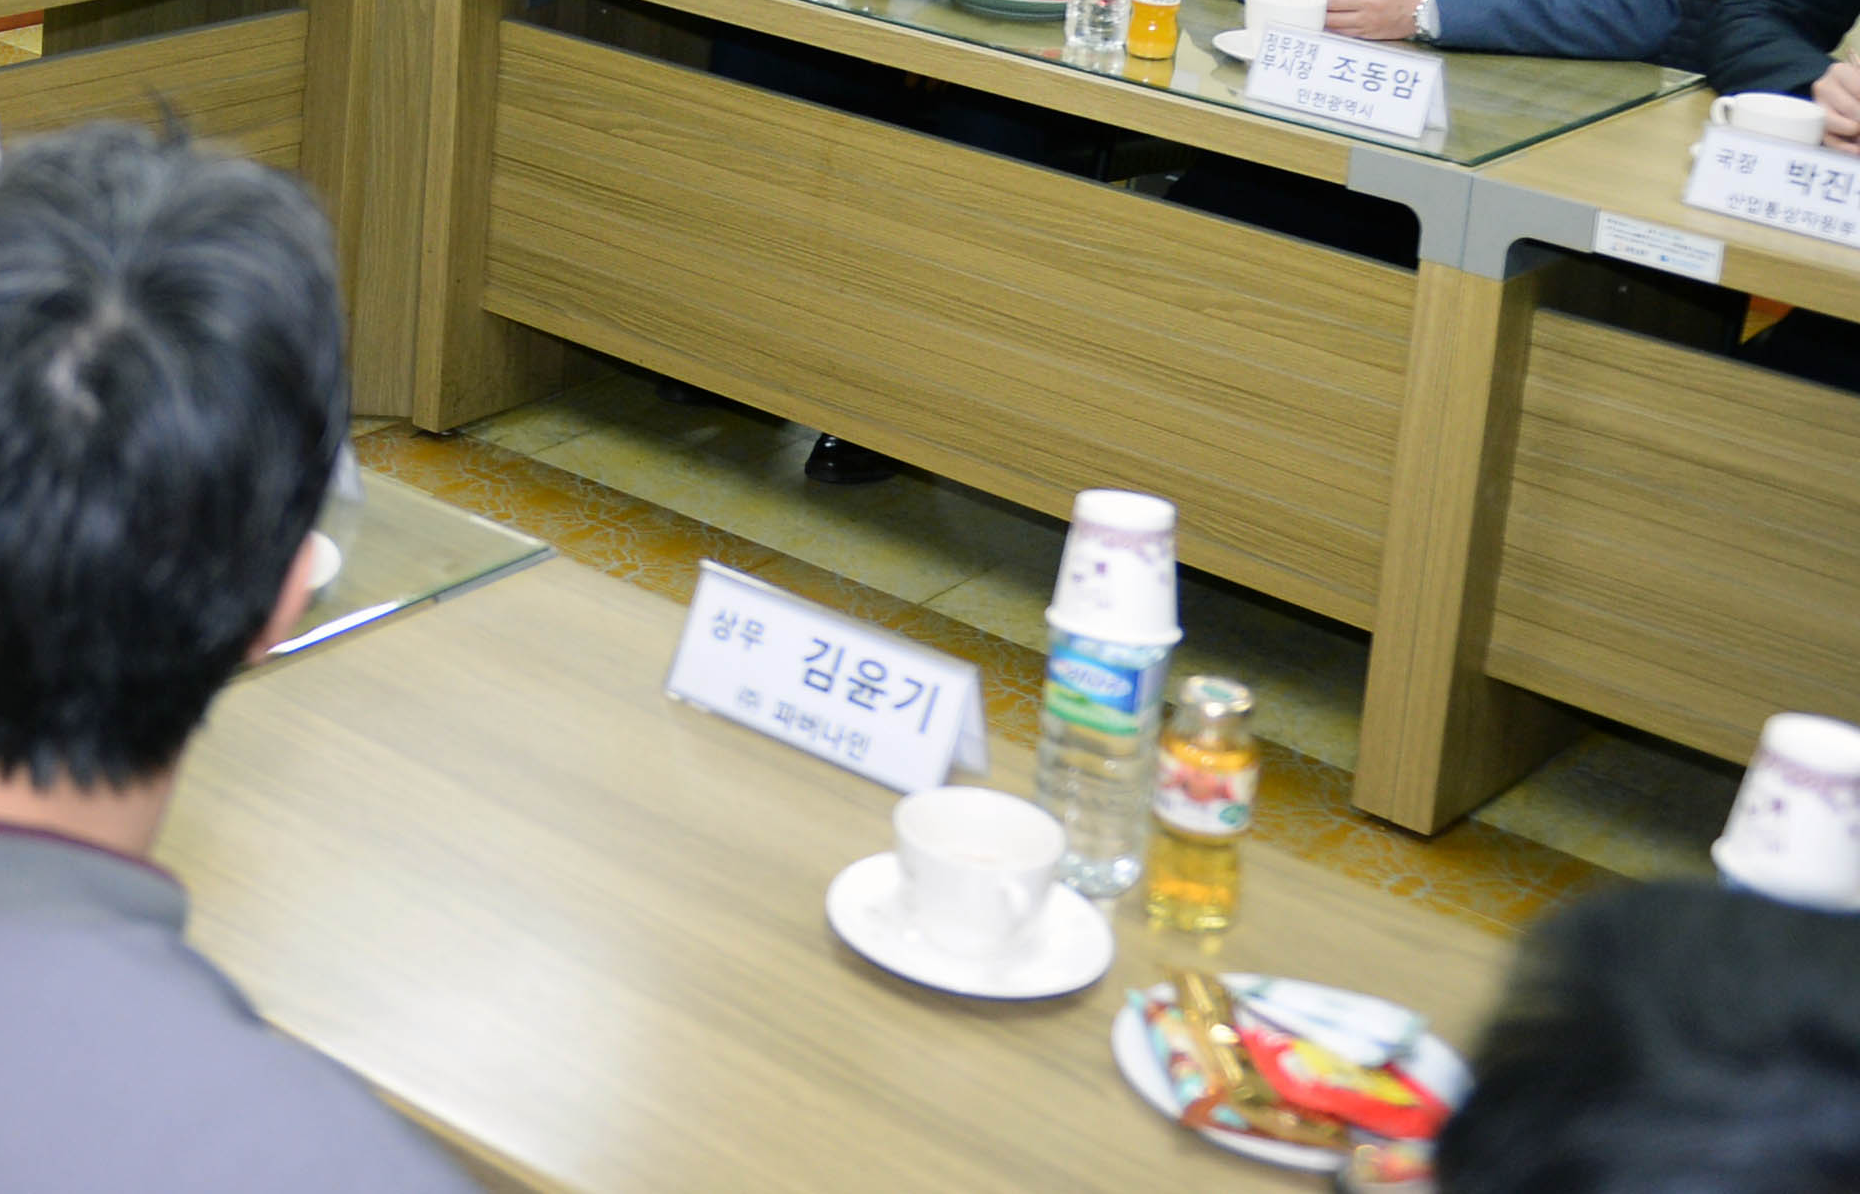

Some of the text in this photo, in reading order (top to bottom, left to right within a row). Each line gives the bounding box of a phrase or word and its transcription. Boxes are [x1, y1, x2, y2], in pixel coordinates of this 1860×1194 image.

[1260, 54, 1313, 80] 부시장
[1328, 56, 1420, 99] 조동암
[1297, 88, 1374, 118] 인천광역시
[1716, 148, 1860, 204] 국장 박진
[1727, 193, 1855, 235] 산업통상자원부
[710, 609, 940, 733] 상무 김윤기
[773, 701, 872, 762] 파버나인
